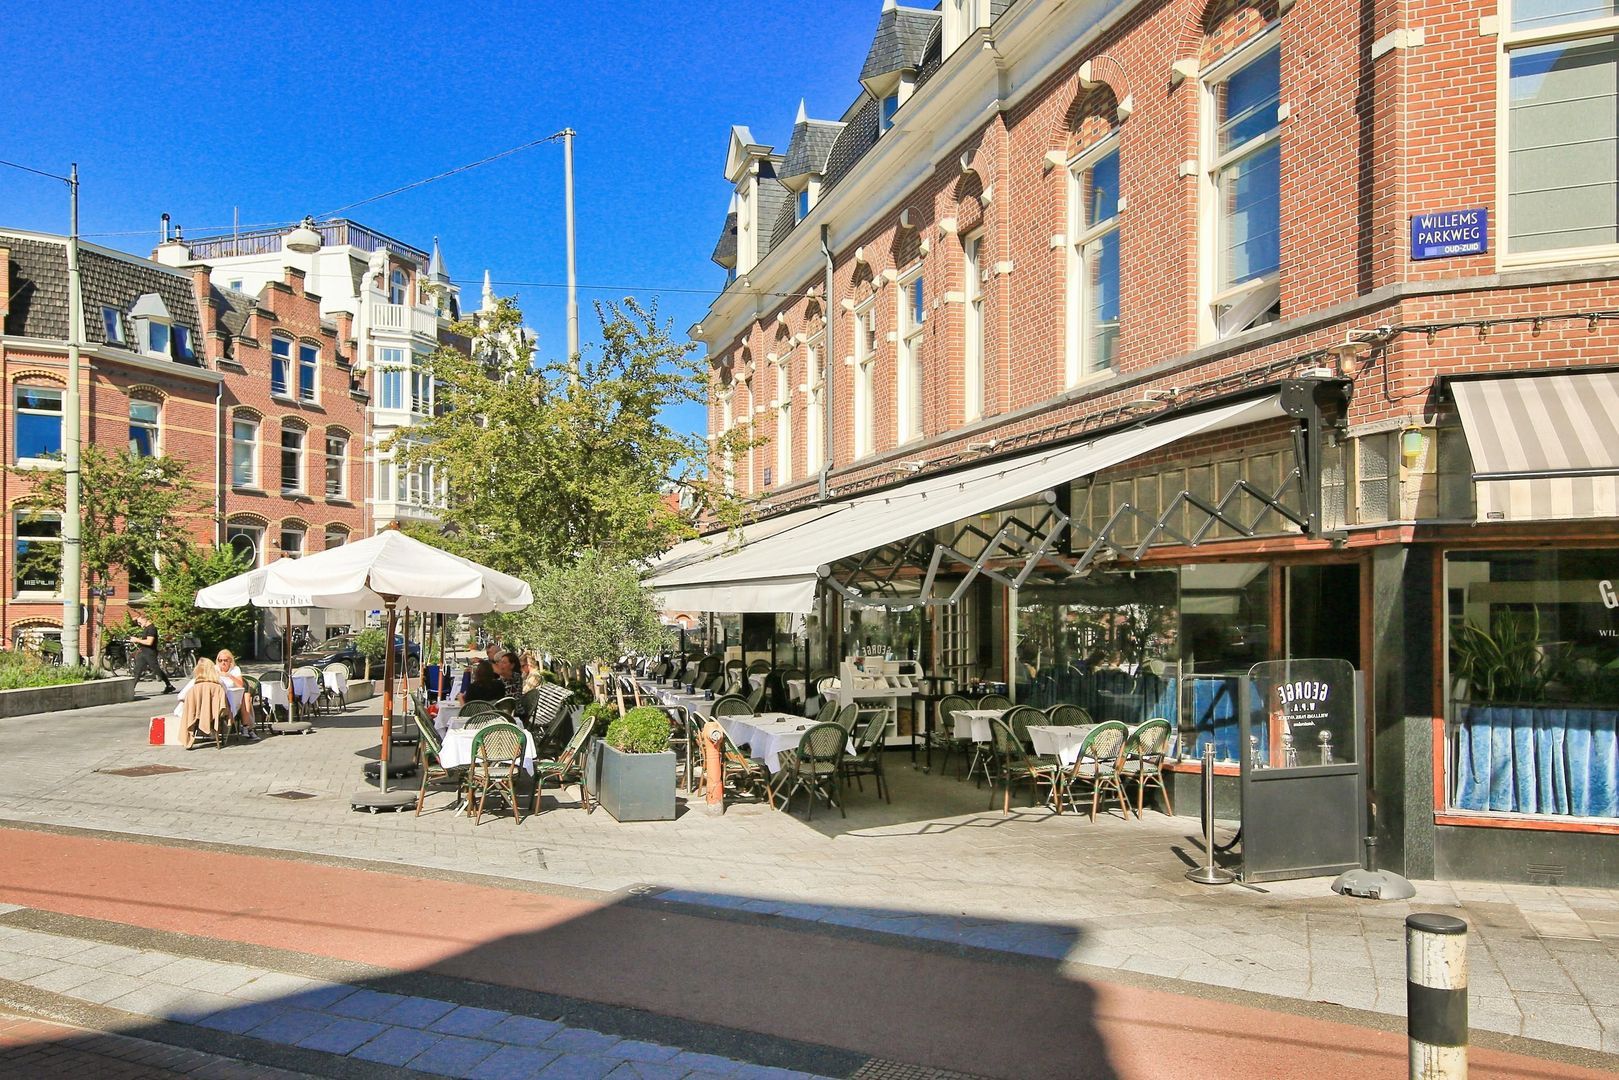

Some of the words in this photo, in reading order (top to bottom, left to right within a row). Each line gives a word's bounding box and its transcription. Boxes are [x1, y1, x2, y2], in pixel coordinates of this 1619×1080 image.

[1421, 213, 1478, 229] WILLEMS
[1418, 227, 1479, 244] PARKWEG
[1444, 243, 1479, 253] OUD-ZUID
